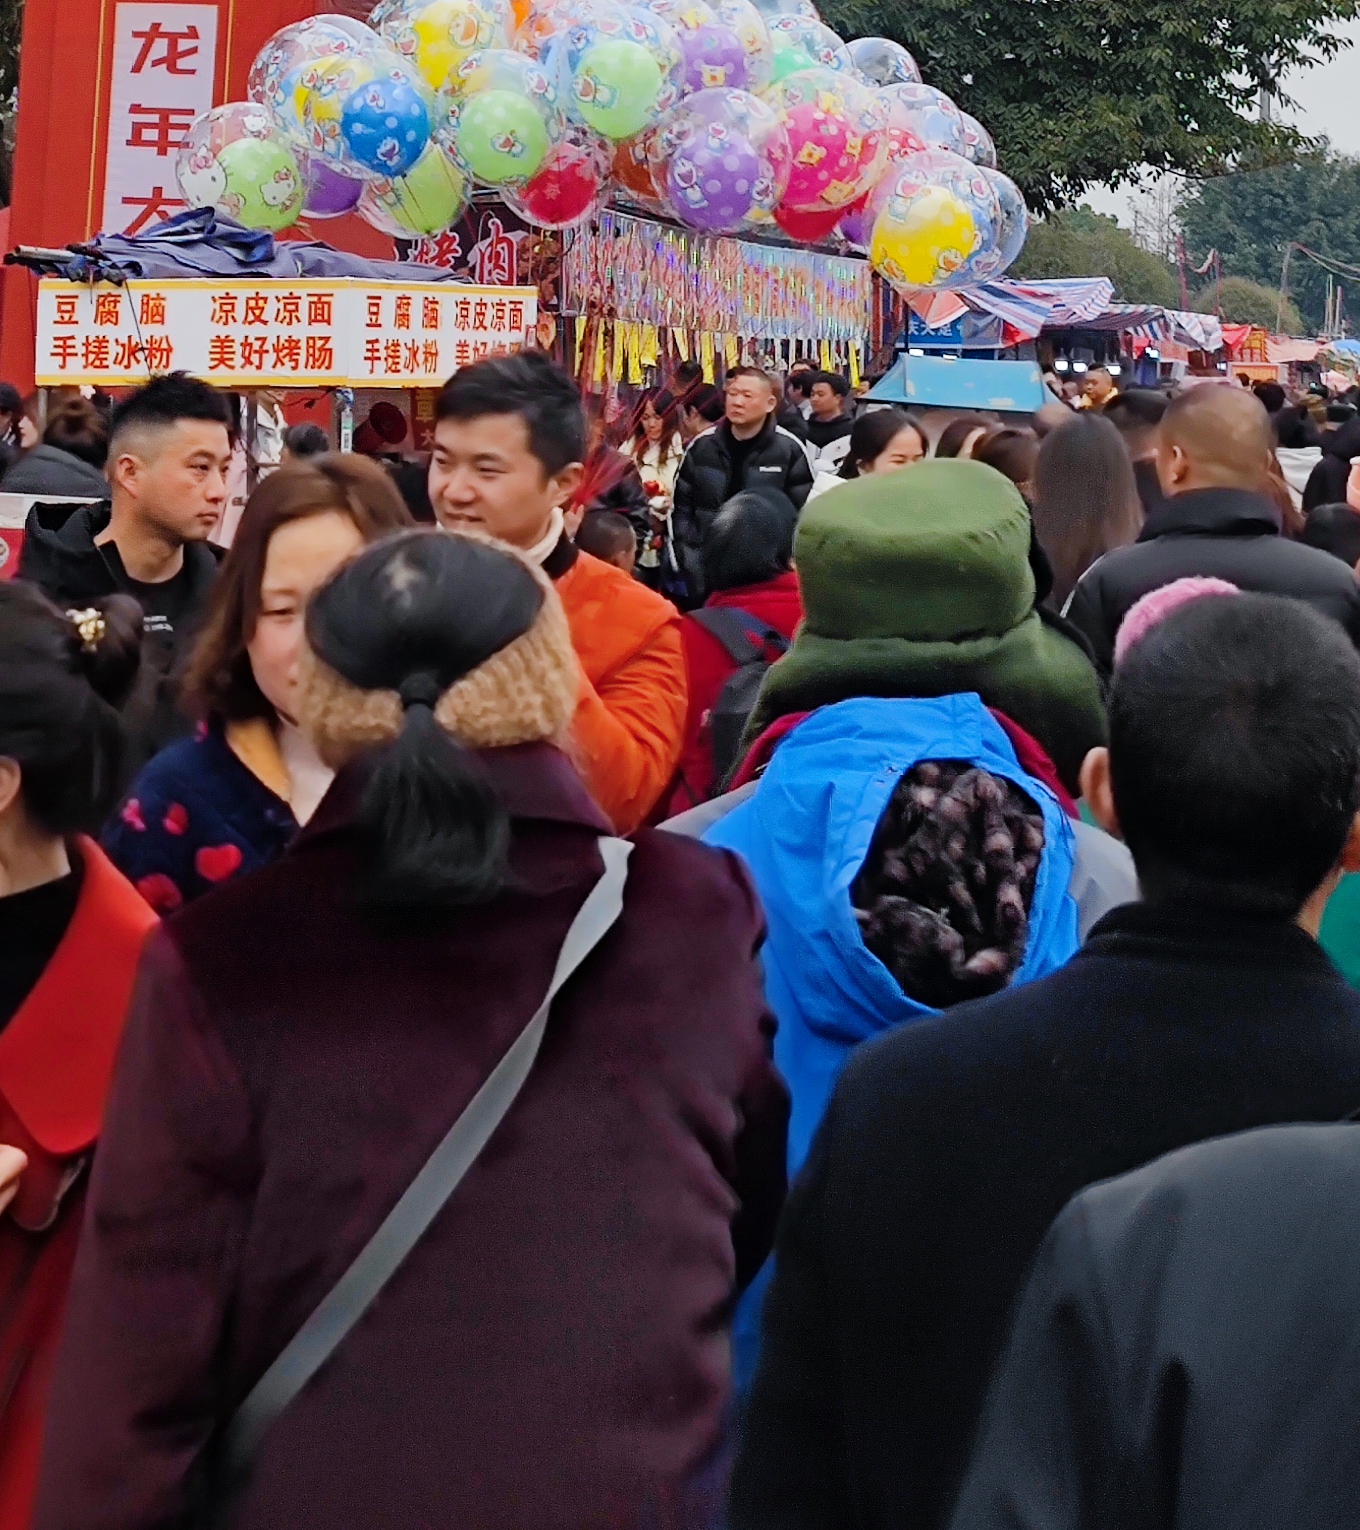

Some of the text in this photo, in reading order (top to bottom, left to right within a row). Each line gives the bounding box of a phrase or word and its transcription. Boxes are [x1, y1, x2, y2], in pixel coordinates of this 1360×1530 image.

[53, 292, 334, 327] 豆腐脑 凉皮凉面
[365, 294, 524, 332] 豆腐脑 凉皮凉面
[50, 334, 334, 372] 手搓冰粉 美好烤肠
[364, 337, 439, 375] 手搓冰粉
